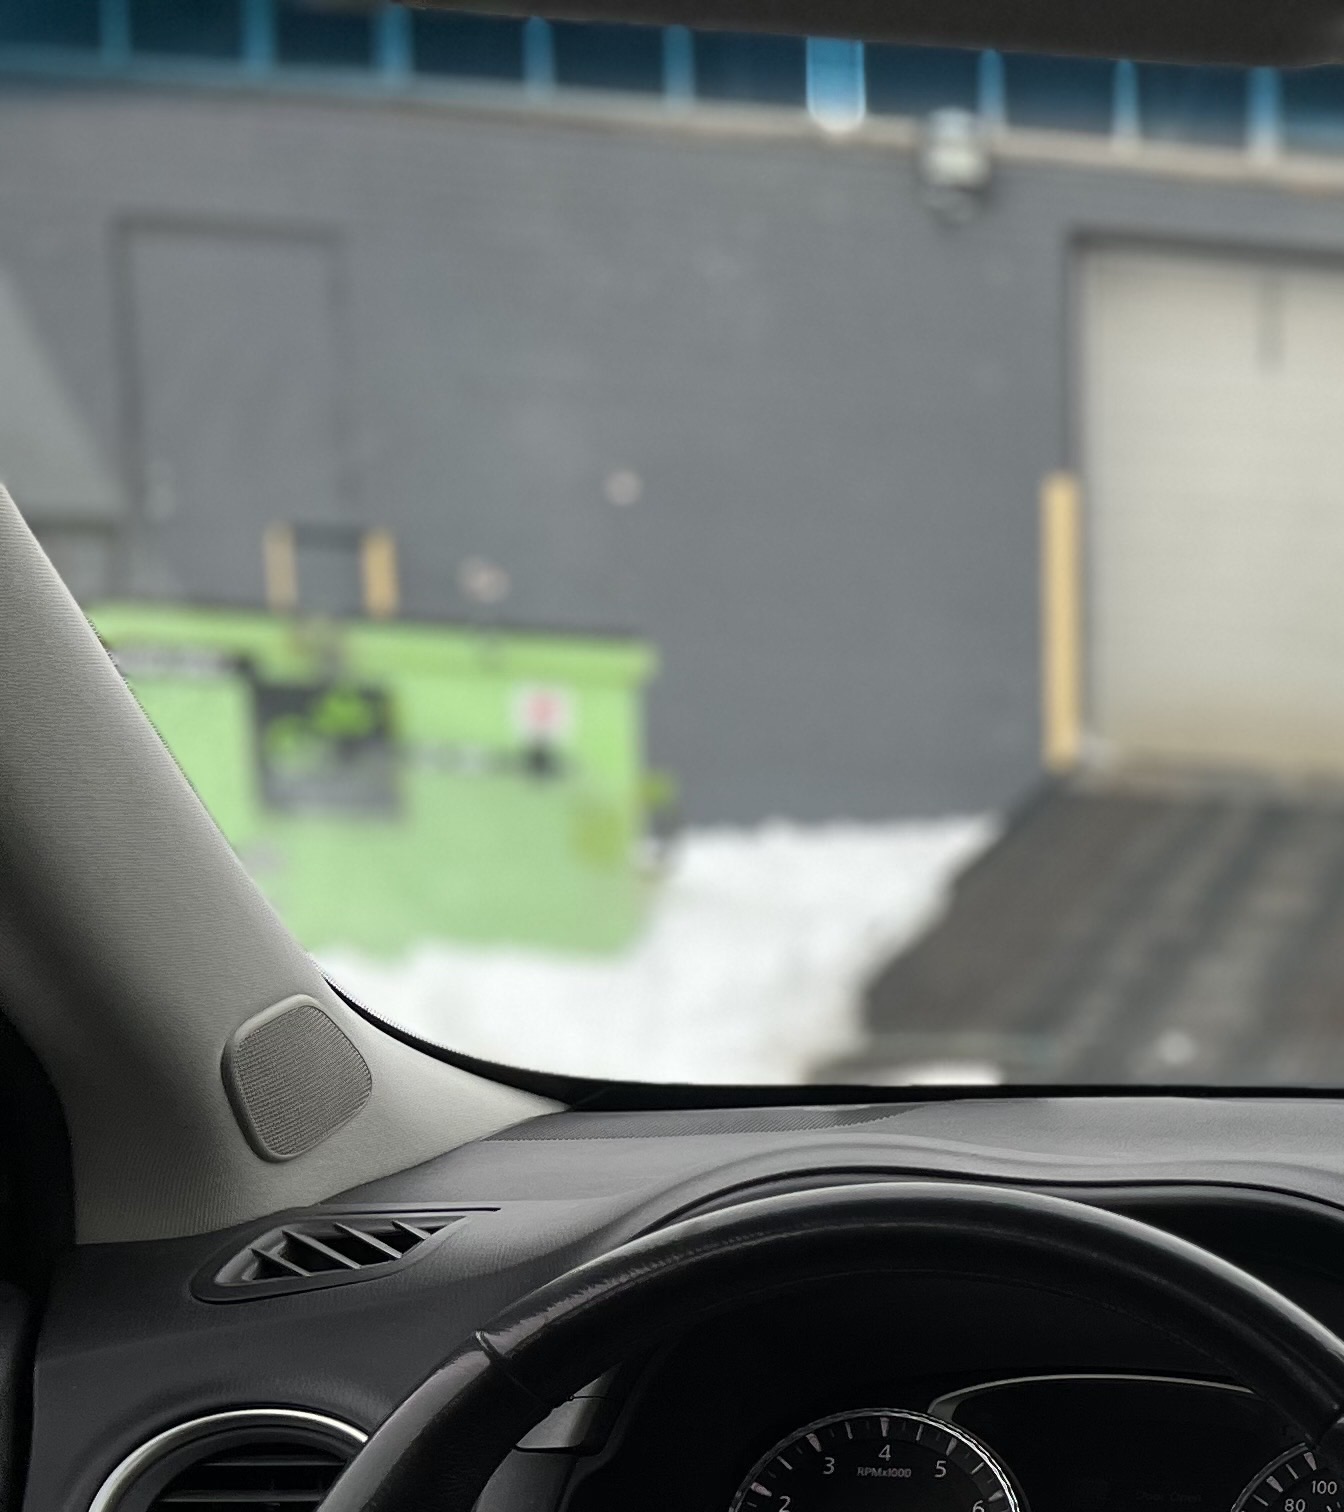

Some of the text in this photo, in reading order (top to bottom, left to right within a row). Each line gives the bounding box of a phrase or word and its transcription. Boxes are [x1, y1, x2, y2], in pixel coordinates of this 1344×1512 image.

[878, 1443, 892, 1461] 4
[823, 1456, 835, 1474] 3
[935, 1460, 947, 1478] 5
[1310, 1479, 1338, 1495] 100
[1283, 1498, 1306, 1512] 80
